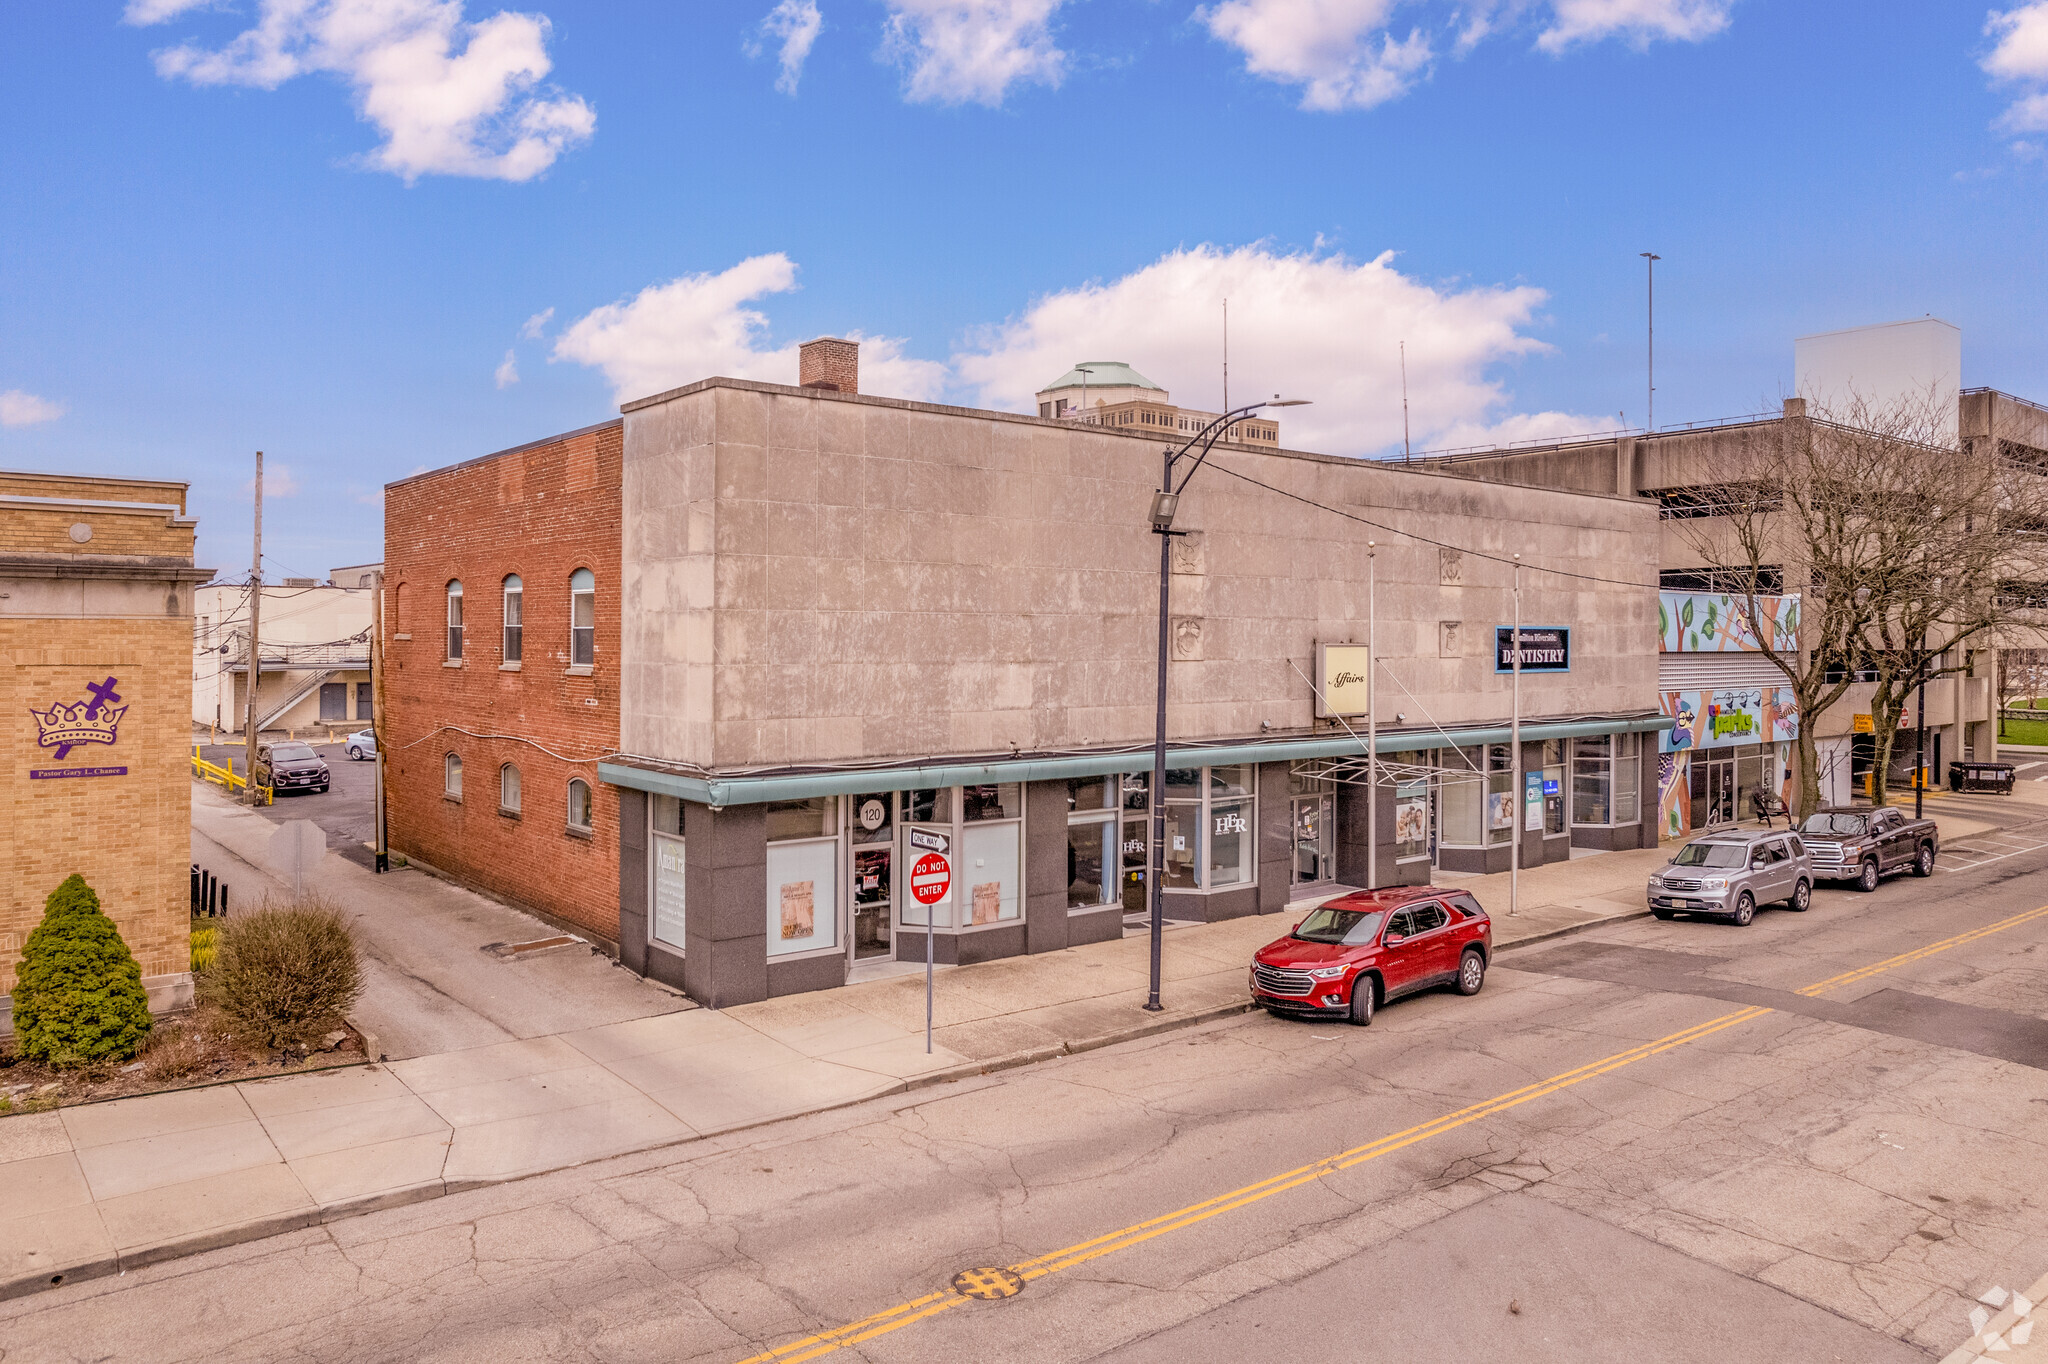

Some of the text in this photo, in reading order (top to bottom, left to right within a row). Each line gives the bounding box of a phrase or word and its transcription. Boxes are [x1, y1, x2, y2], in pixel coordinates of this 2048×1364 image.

[1327, 671, 1365, 688] Affairs
[1713, 708, 1753, 740] parks
[63, 769, 82, 777] Gary
[864, 808, 881, 821] 120
[1214, 813, 1247, 833] HER
[913, 833, 938, 846] ONE WAY
[1123, 839, 1145, 852] HER
[916, 861, 945, 874] DO NOT
[919, 884, 943, 897] ENTER
